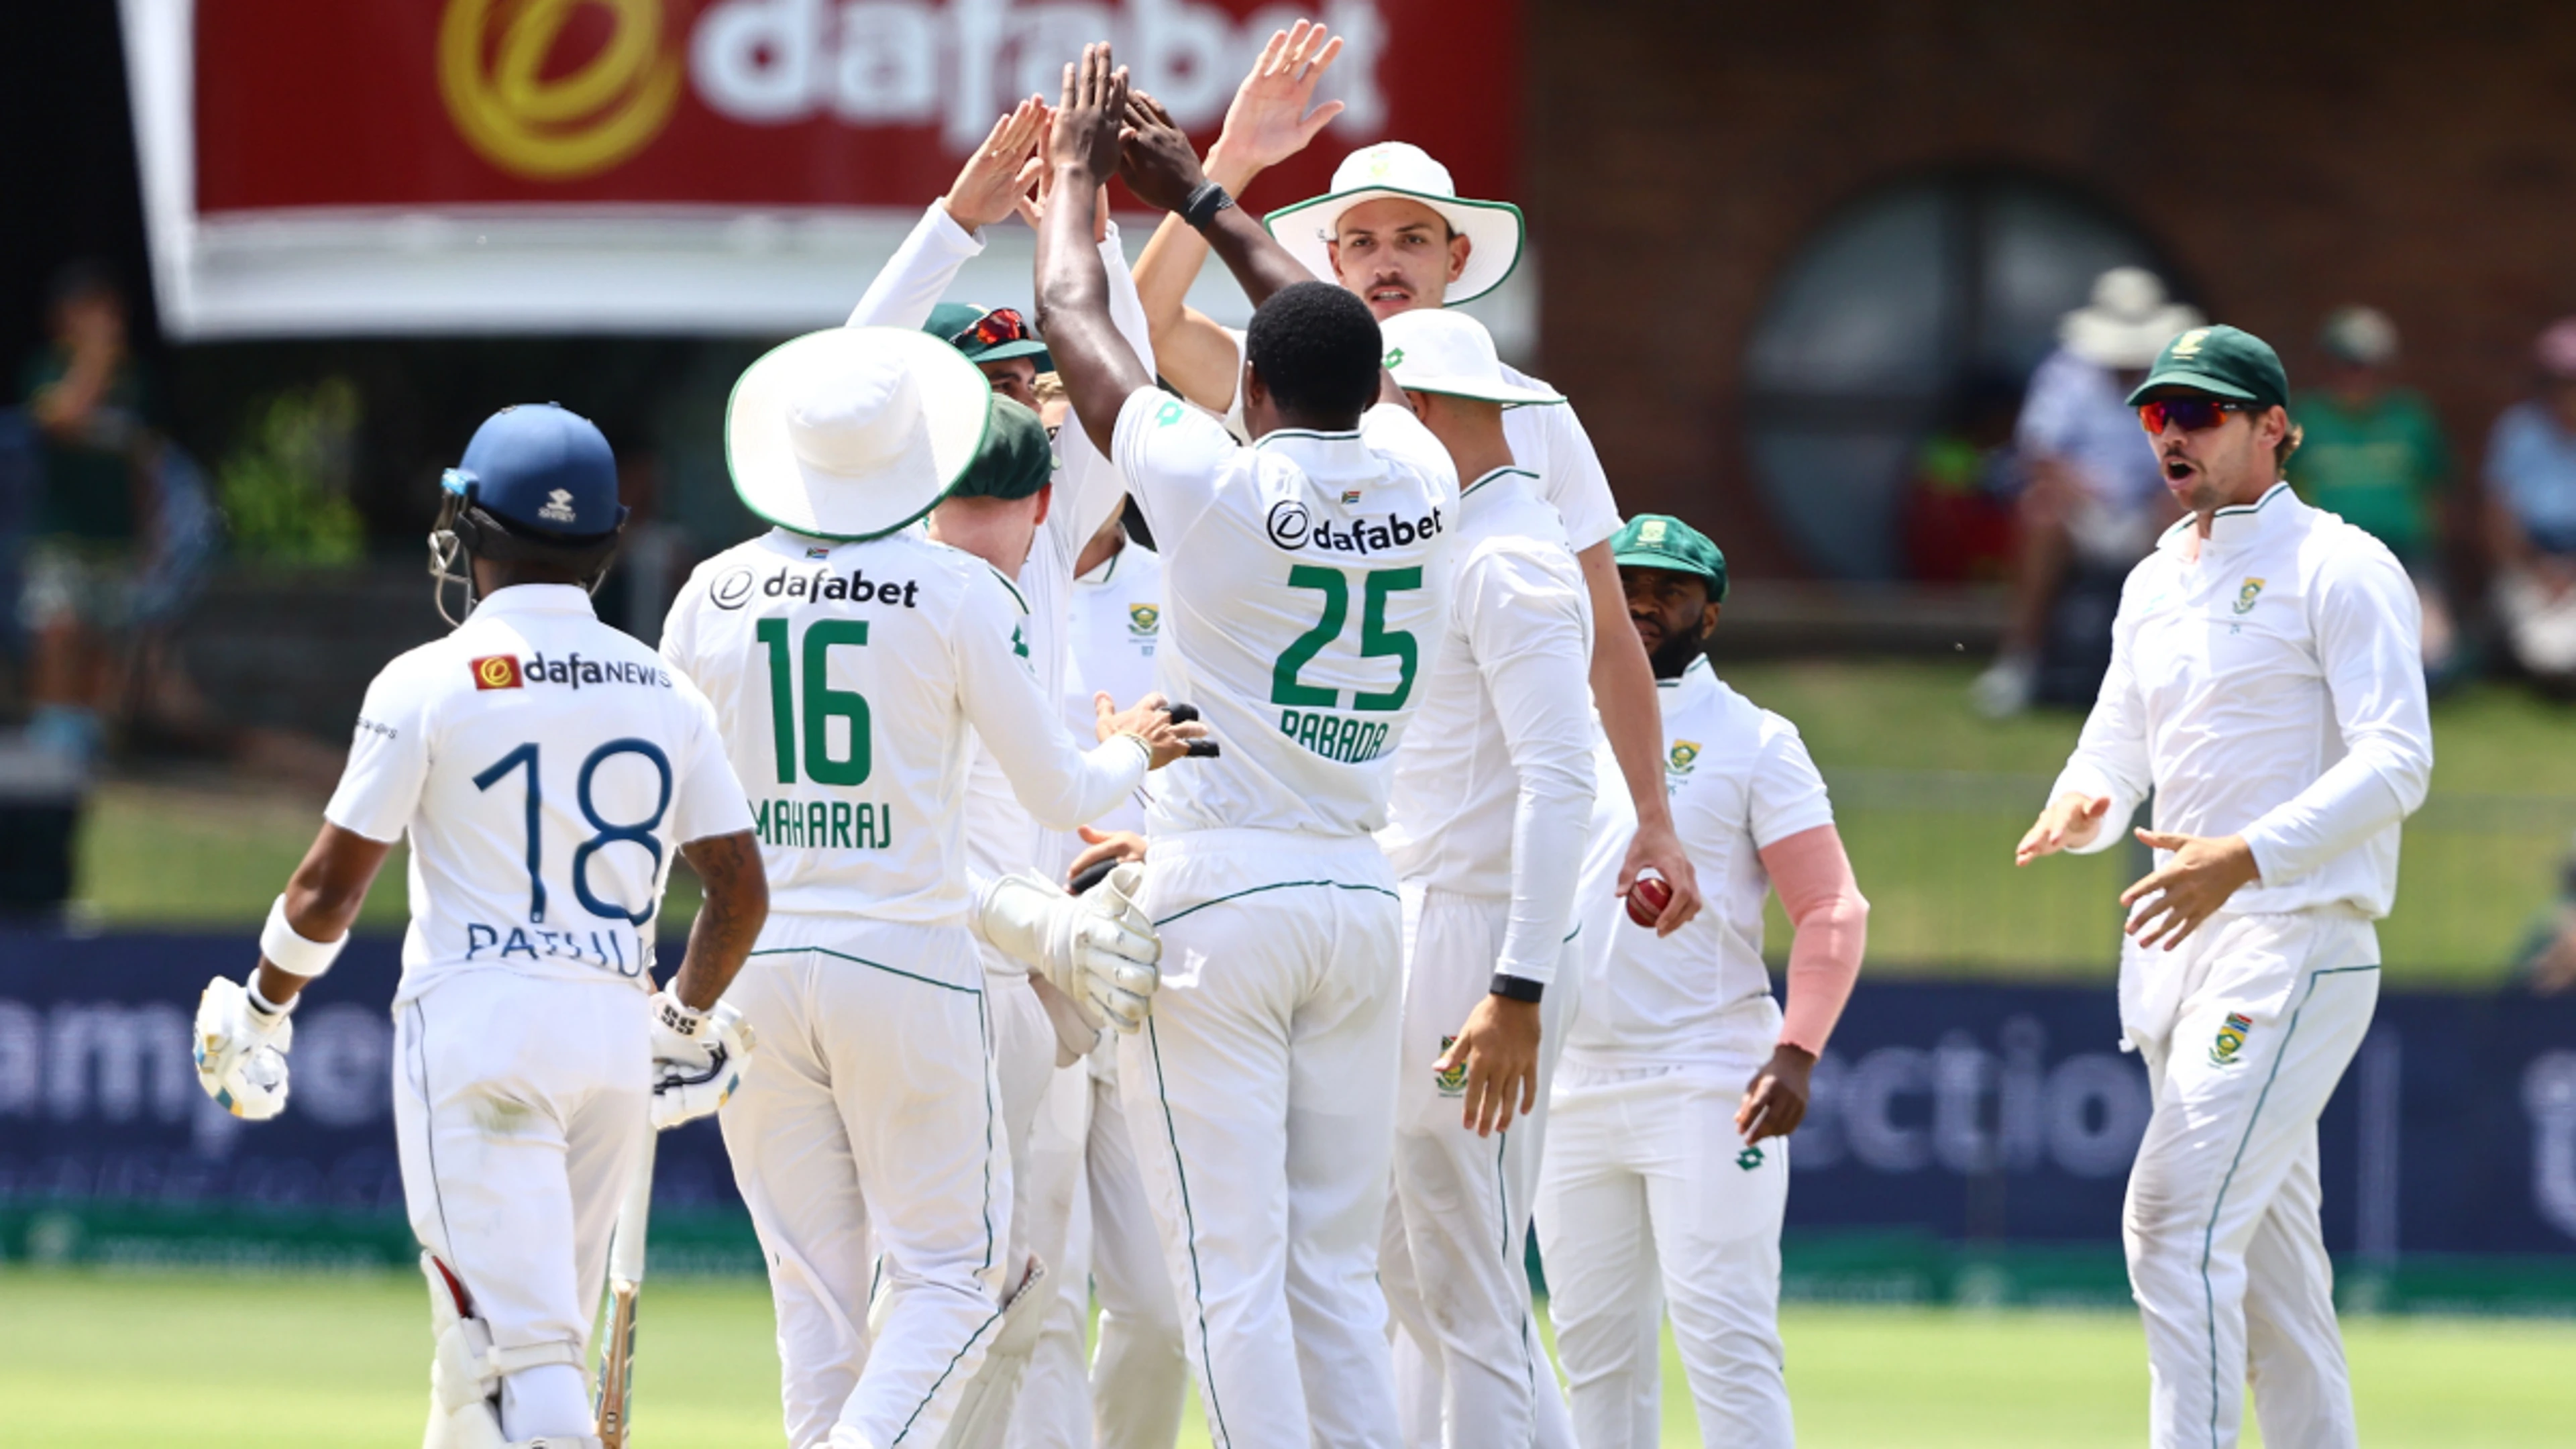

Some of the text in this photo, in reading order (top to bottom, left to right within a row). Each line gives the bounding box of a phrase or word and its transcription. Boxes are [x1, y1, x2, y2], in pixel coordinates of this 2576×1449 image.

[1313, 505, 1443, 555] dafabet
[763, 567, 918, 607] dafabet
[1271, 564, 1423, 711] 25
[523, 650, 672, 690] dafaNEWS
[757, 618, 871, 786] 16
[472, 737, 672, 927] 18
[747, 798, 892, 849] MAHARAJ
